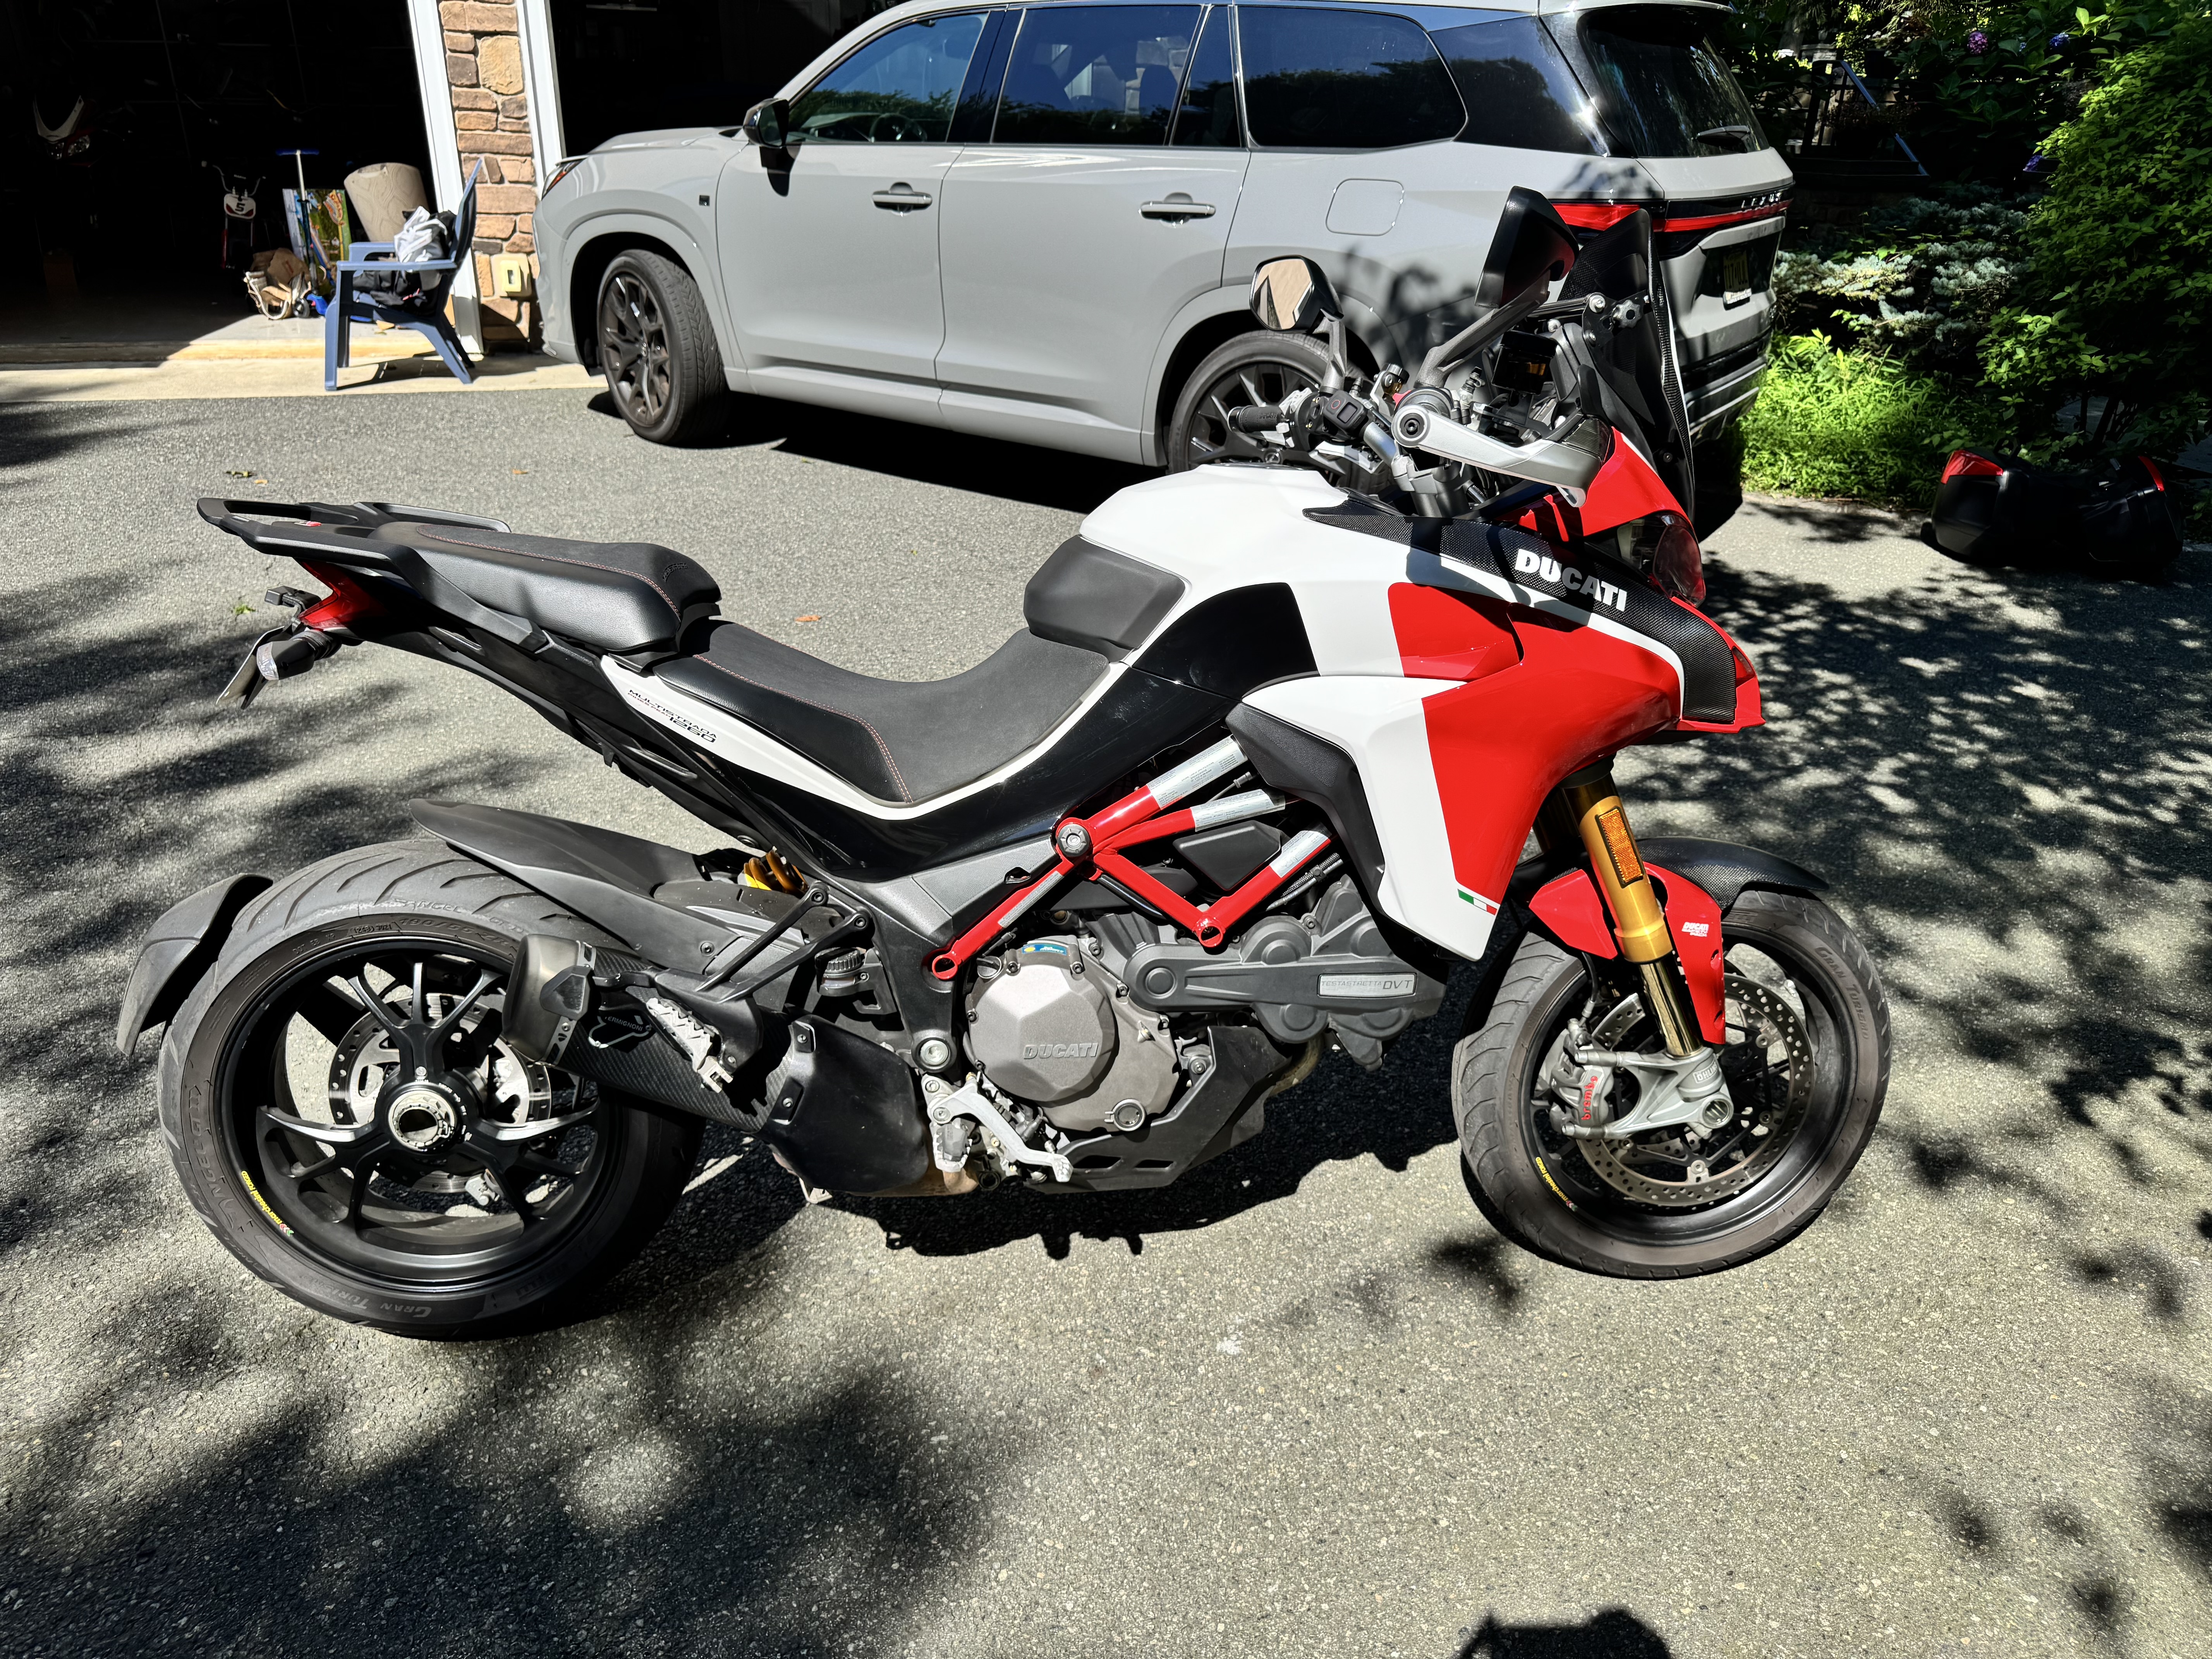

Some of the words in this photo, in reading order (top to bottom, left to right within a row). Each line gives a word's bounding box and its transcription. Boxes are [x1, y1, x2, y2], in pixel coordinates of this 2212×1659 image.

[235, 202, 245, 212] 5
[1515, 548, 1627, 612] DUCATI
[629, 690, 716, 738] MULTISTRADA
[670, 716, 716, 743] 1260
[1382, 980, 1413, 989] DVT
[1023, 1042, 1099, 1060] DUCATI
[1581, 1075, 1598, 1120] brembo
[250, 1190, 283, 1225] marchesini
[380, 1303, 432, 1317] GRAN
